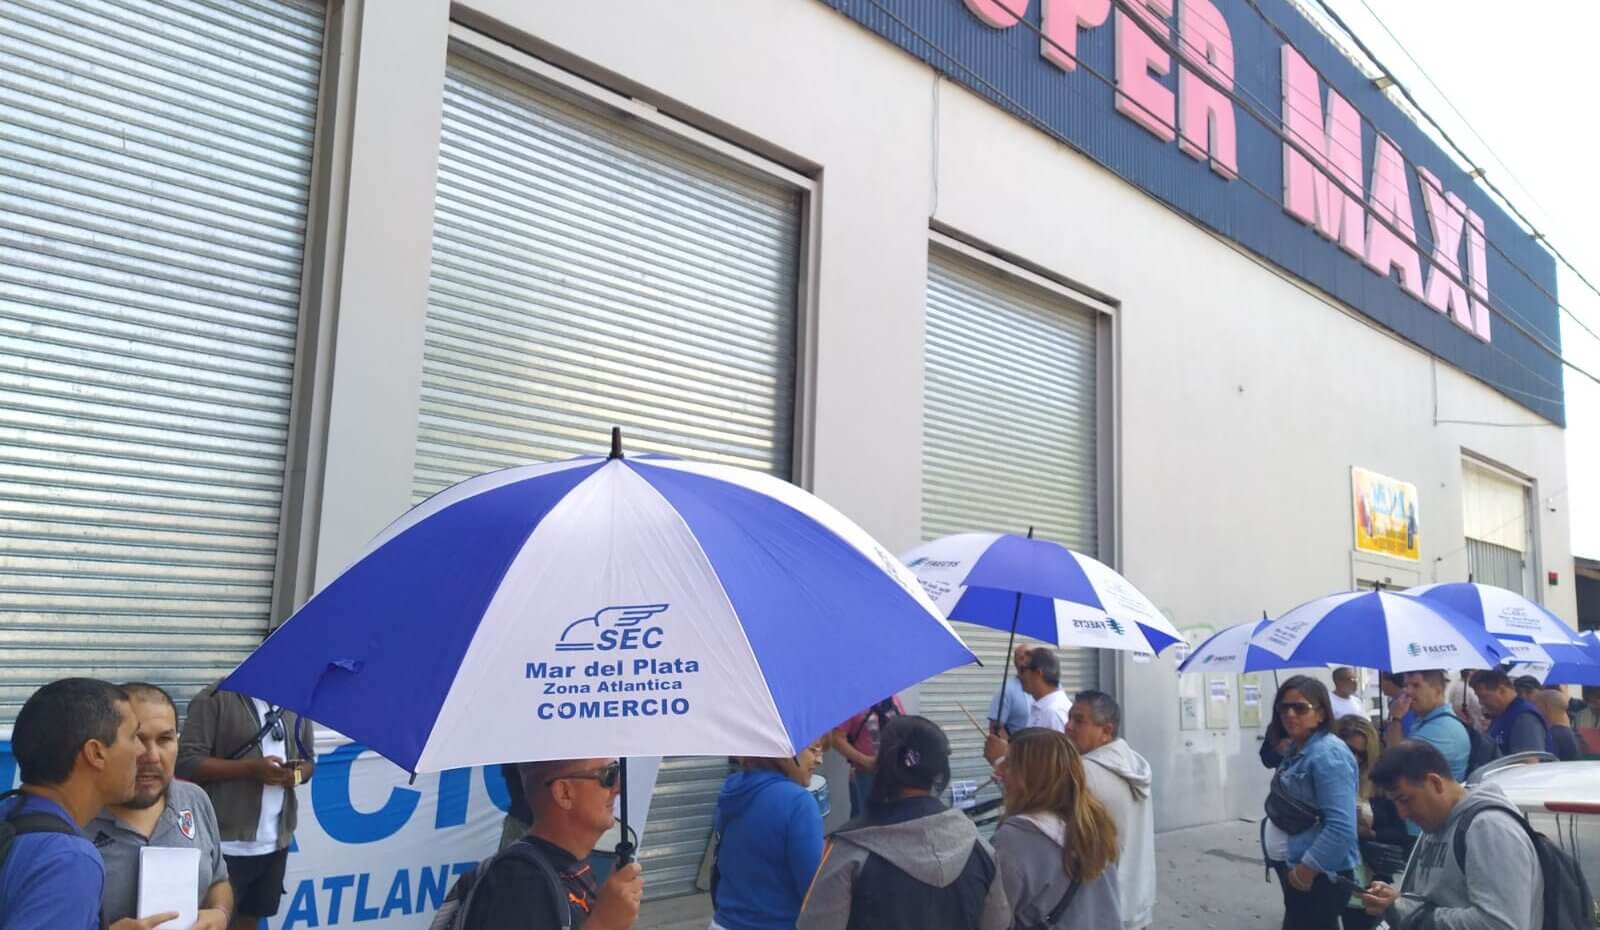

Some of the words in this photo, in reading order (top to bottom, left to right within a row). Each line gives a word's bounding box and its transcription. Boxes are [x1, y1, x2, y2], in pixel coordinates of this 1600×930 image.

[963, 0, 1238, 180] ER
[1281, 43, 1491, 343] MAXI
[597, 627, 664, 651] SEC
[525, 662, 576, 679] Mar
[584, 660, 624, 677] del
[633, 657, 699, 675] Plata
[543, 682, 591, 694] Zona
[597, 678, 682, 693] Atlantica
[537, 698, 690, 720] COMERCIO
